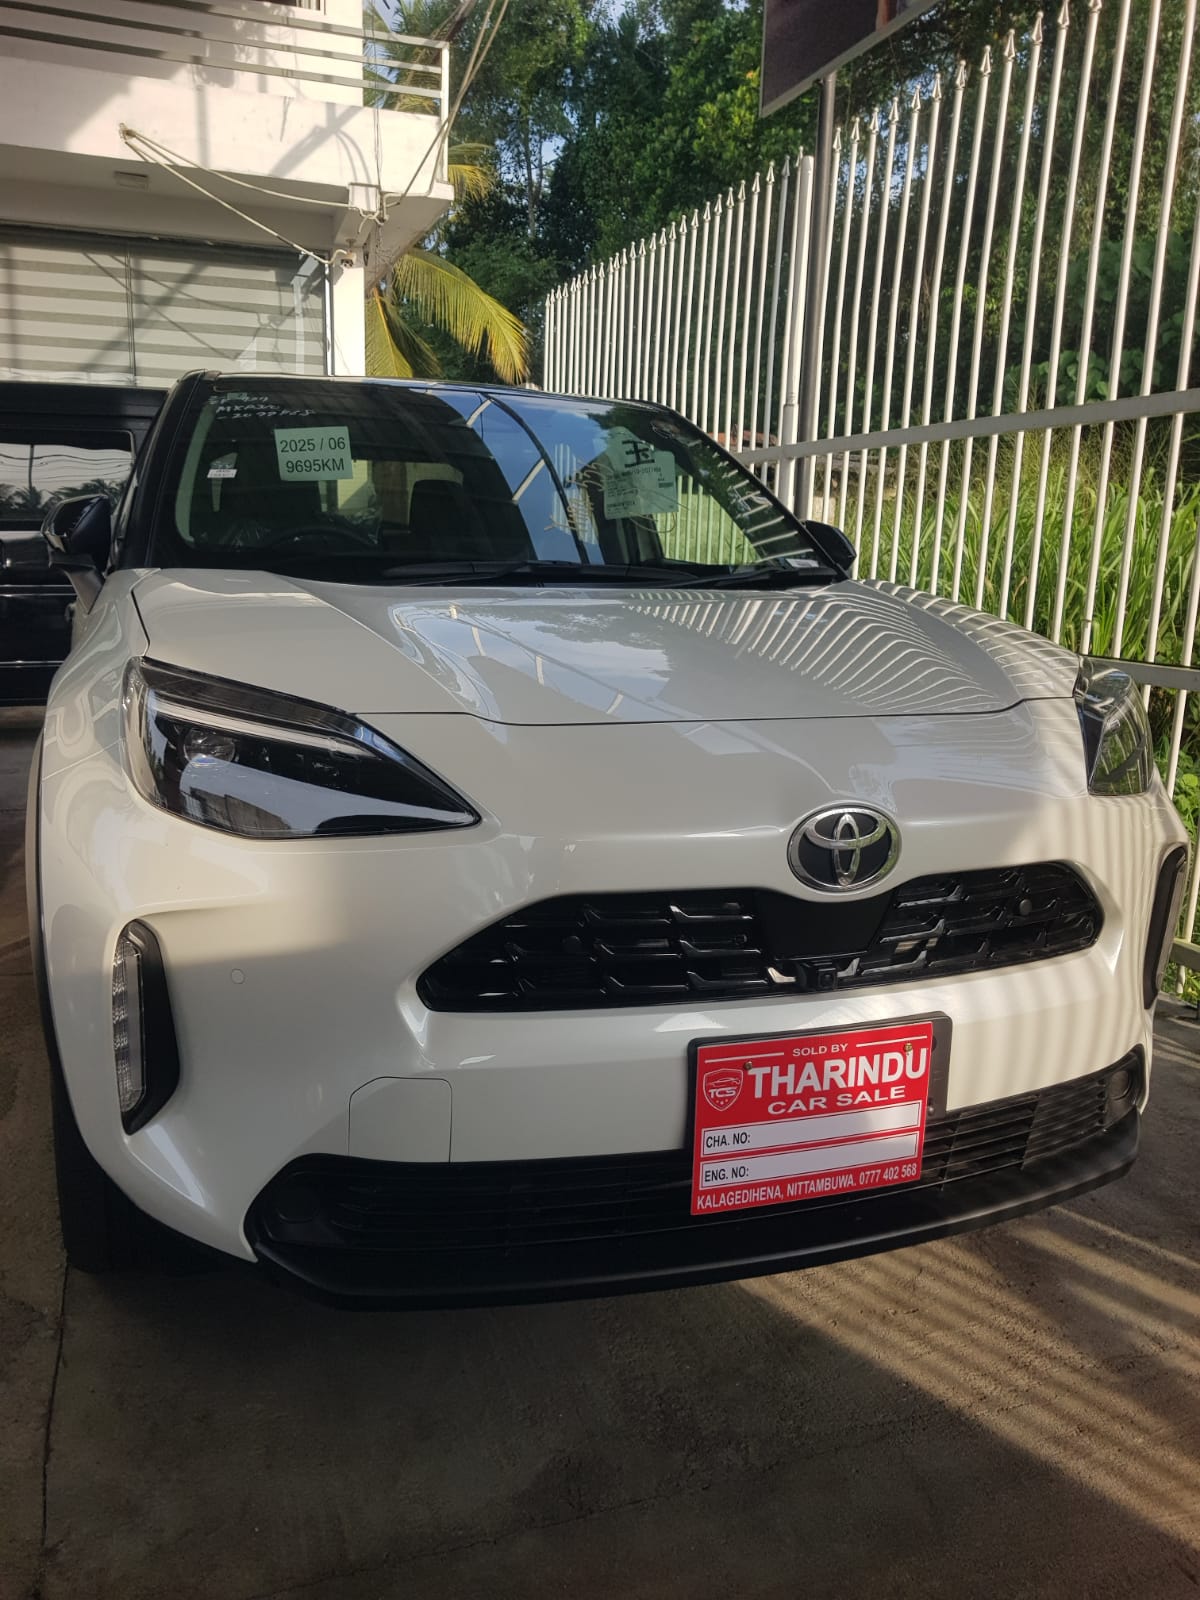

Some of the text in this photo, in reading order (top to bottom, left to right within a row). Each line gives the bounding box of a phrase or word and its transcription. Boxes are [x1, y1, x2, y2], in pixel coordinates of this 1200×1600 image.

[280, 438, 315, 453] 2025
[328, 437, 346, 450] 06
[286, 458, 345, 473] 9695KM
[792, 1043, 848, 1057] SOLD BY
[748, 1048, 926, 1098] THARINDU
[708, 1087, 737, 1098] TCS
[768, 1085, 905, 1115] CAR SALE
[706, 1132, 751, 1148] CHA. NO:
[704, 1166, 749, 1182] ENG. NO:
[697, 1185, 784, 1209] KALAGEDIHENA,
[859, 1169, 881, 1185] 0777
[883, 1166, 899, 1180] 402
[901, 1163, 917, 1177] 568
